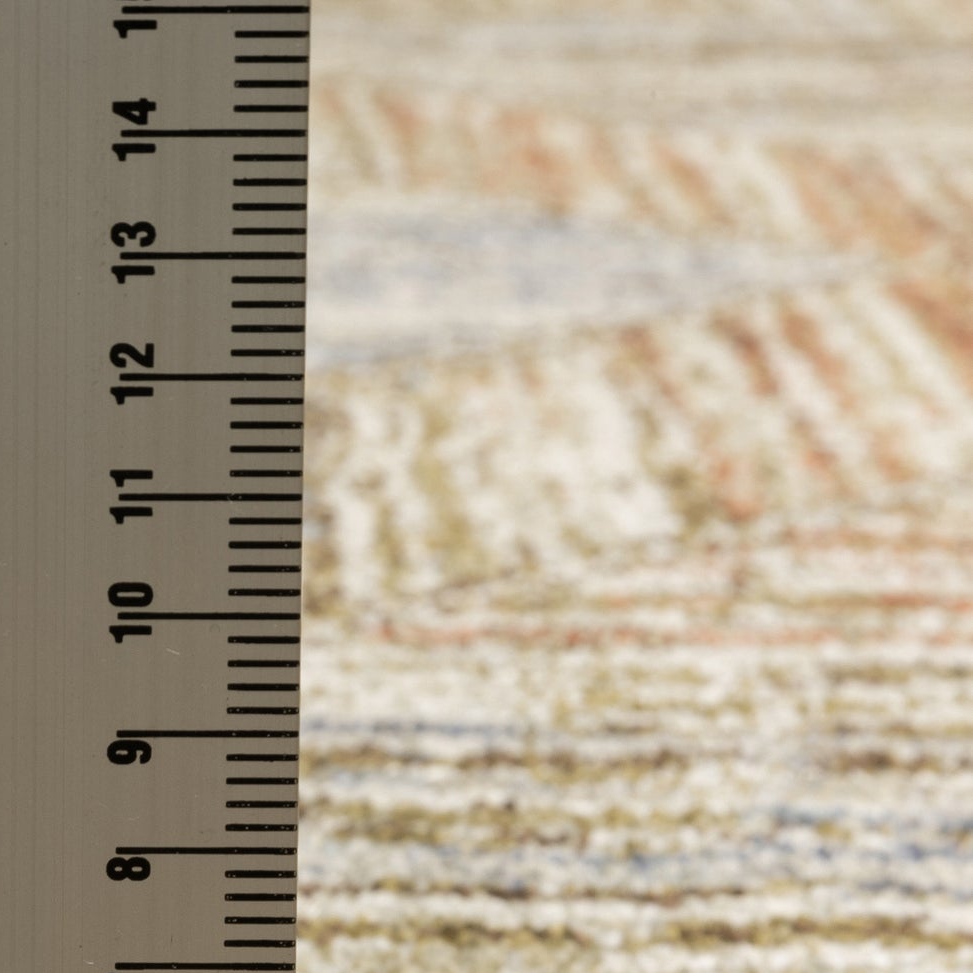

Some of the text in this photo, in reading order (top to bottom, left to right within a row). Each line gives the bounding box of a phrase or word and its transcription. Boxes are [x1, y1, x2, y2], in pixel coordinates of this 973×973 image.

[112, 0, 158, 39] 1
[111, 97, 157, 162] 14
[110, 221, 157, 285] 13
[109, 342, 155, 406] 12
[109, 469, 154, 525] 11
[107, 581, 154, 644] 10
[106, 739, 153, 765] 9
[105, 856, 151, 882] 8
